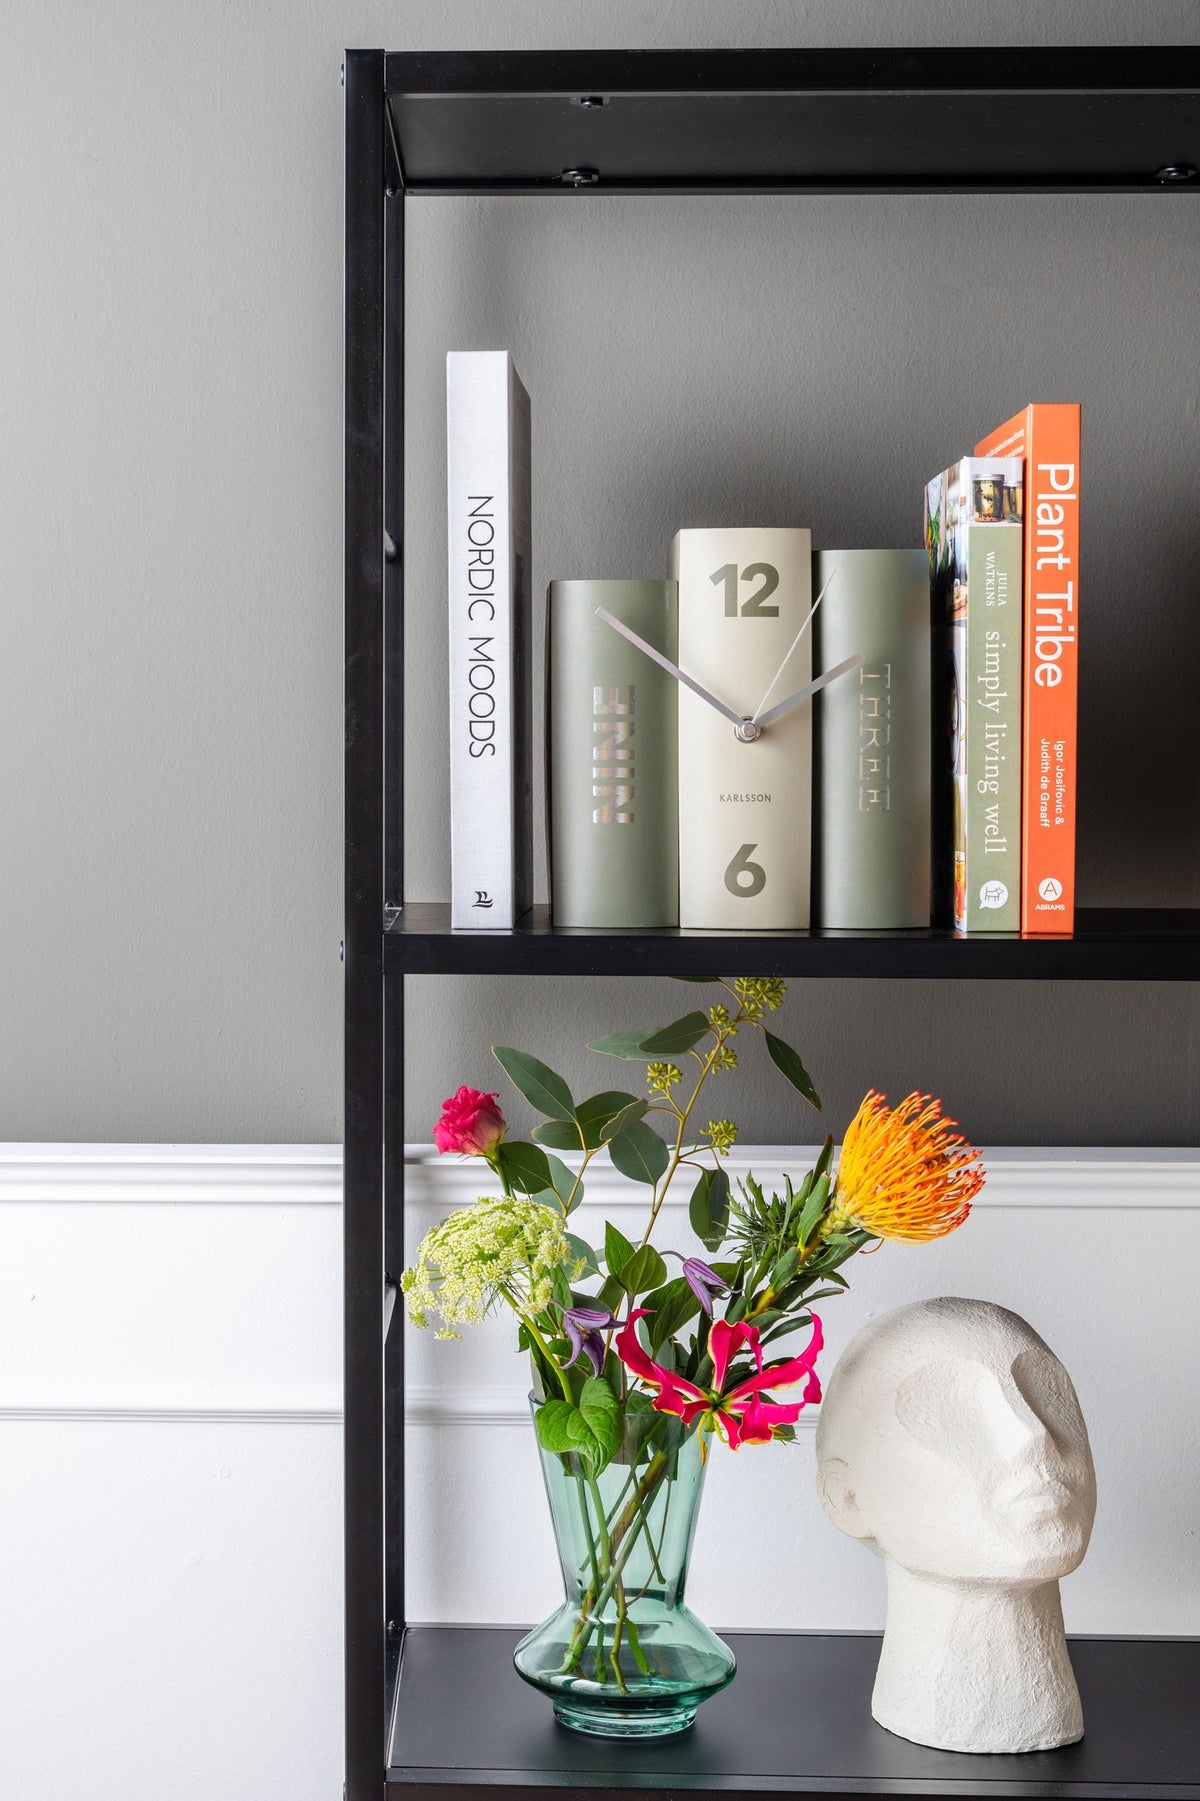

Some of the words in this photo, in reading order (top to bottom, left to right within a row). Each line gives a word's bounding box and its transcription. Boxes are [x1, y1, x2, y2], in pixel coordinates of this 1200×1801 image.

[1036, 463, 1076, 571] Plant
[467, 496, 494, 621] NORDIC
[986, 551, 995, 607] WATKINS
[709, 562, 780, 617] 12
[997, 572, 1007, 606] JULIA
[1034, 581, 1075, 687] Tribe
[468, 636, 495, 759] MOODS
[978, 631, 1007, 714] simply
[593, 685, 635, 823] NINE
[859, 664, 890, 811] THREE
[978, 722, 1007, 794] living
[1040, 738, 1050, 772] Judith
[1053, 740, 1066, 763] Igor
[719, 794, 772, 802] KARLSSON
[1039, 792, 1050, 827] Graaff
[1040, 776, 1049, 789] de
[1055, 765, 1066, 814] Josifovic
[984, 803, 1007, 855] well
[1054, 816, 1065, 825] &
[723, 844, 767, 898] 6
[1035, 903, 1066, 911] ABRAMS
